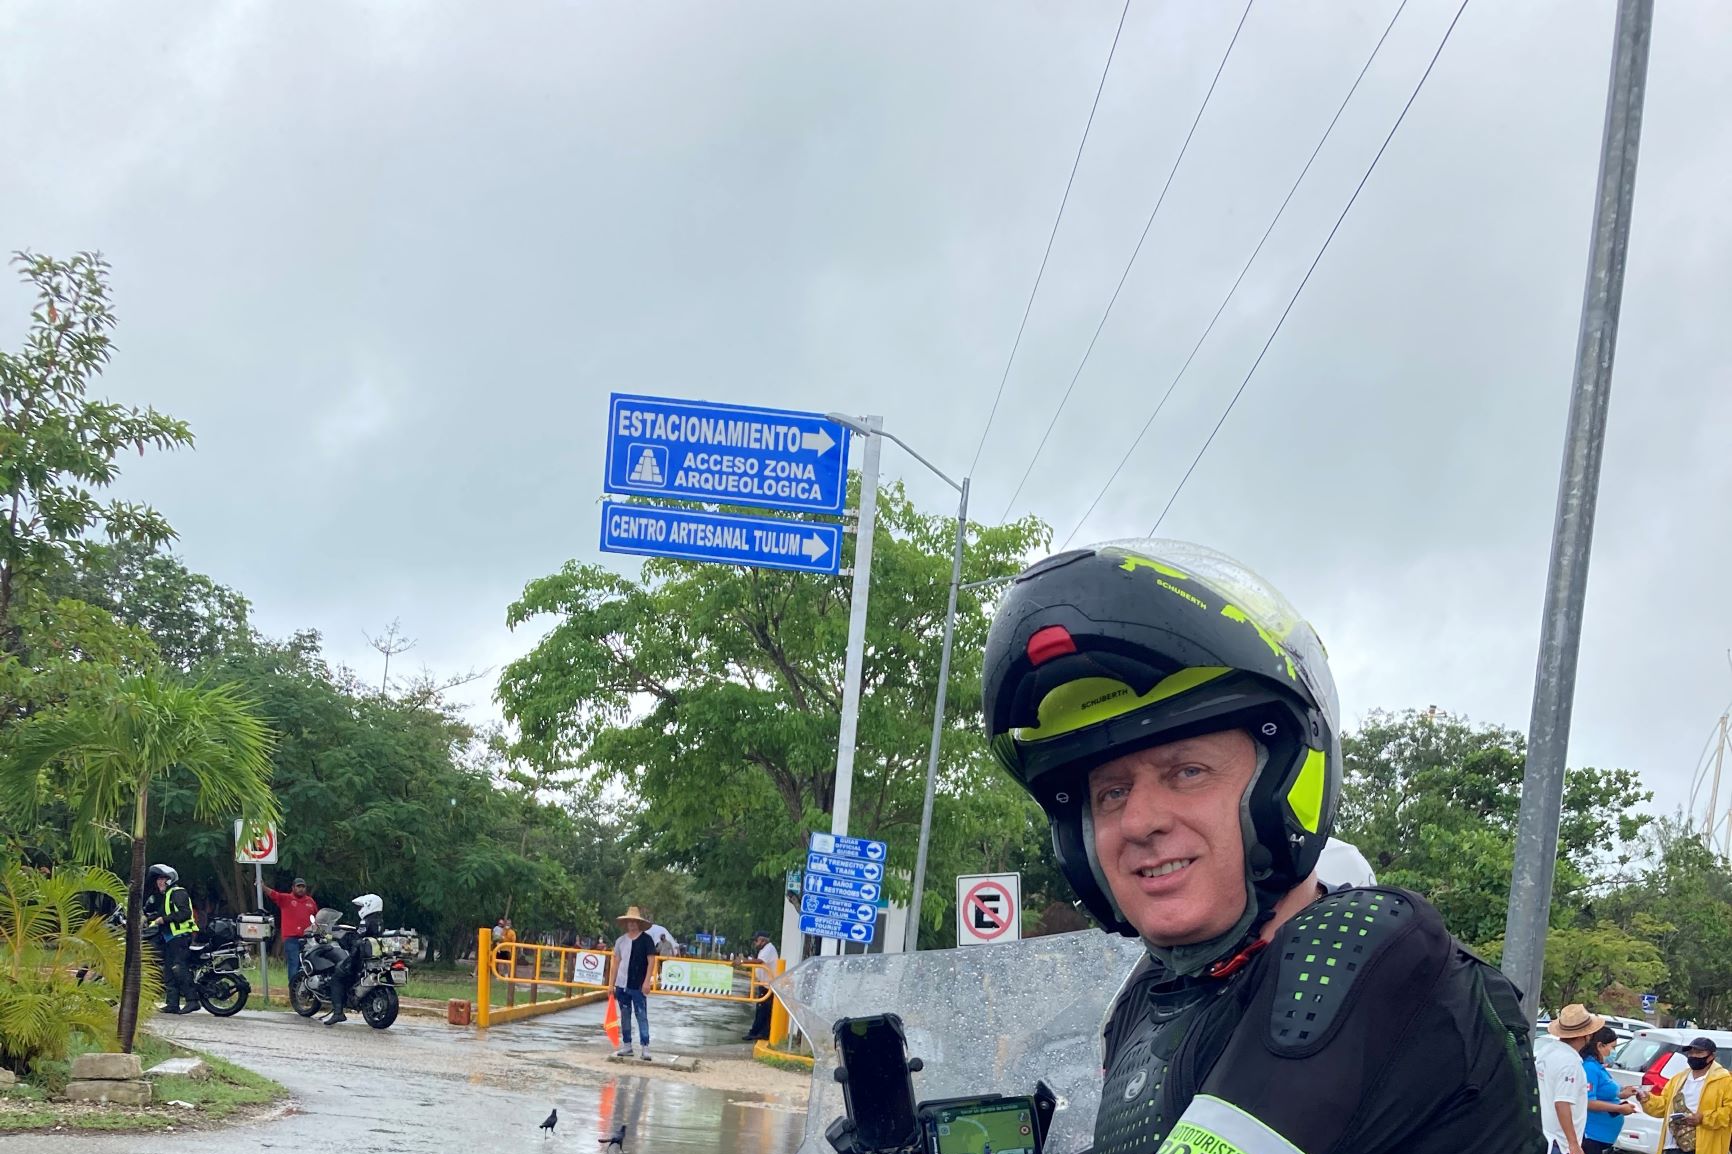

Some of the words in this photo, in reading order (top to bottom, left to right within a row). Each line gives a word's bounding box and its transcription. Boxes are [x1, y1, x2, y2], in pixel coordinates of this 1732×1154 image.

[618, 410, 800, 453] ESTACIONAMIENTO
[683, 452, 759, 475] ACCESO
[763, 460, 816, 481] ZONA
[673, 470, 822, 500] ARQUEOLOGICA
[611, 515, 666, 542] CENTRO
[669, 521, 749, 551] ARTESANAL
[753, 530, 800, 556] TULUM
[1156, 579, 1207, 610] SCHUBERTH
[1081, 688, 1128, 710] SCHUBERTH
[835, 867, 856, 876] TRAIN
[824, 886, 860, 897] RESTROOMS
[822, 904, 857, 914] ARTESANAL
[805, 927, 849, 938] INFORMATION
